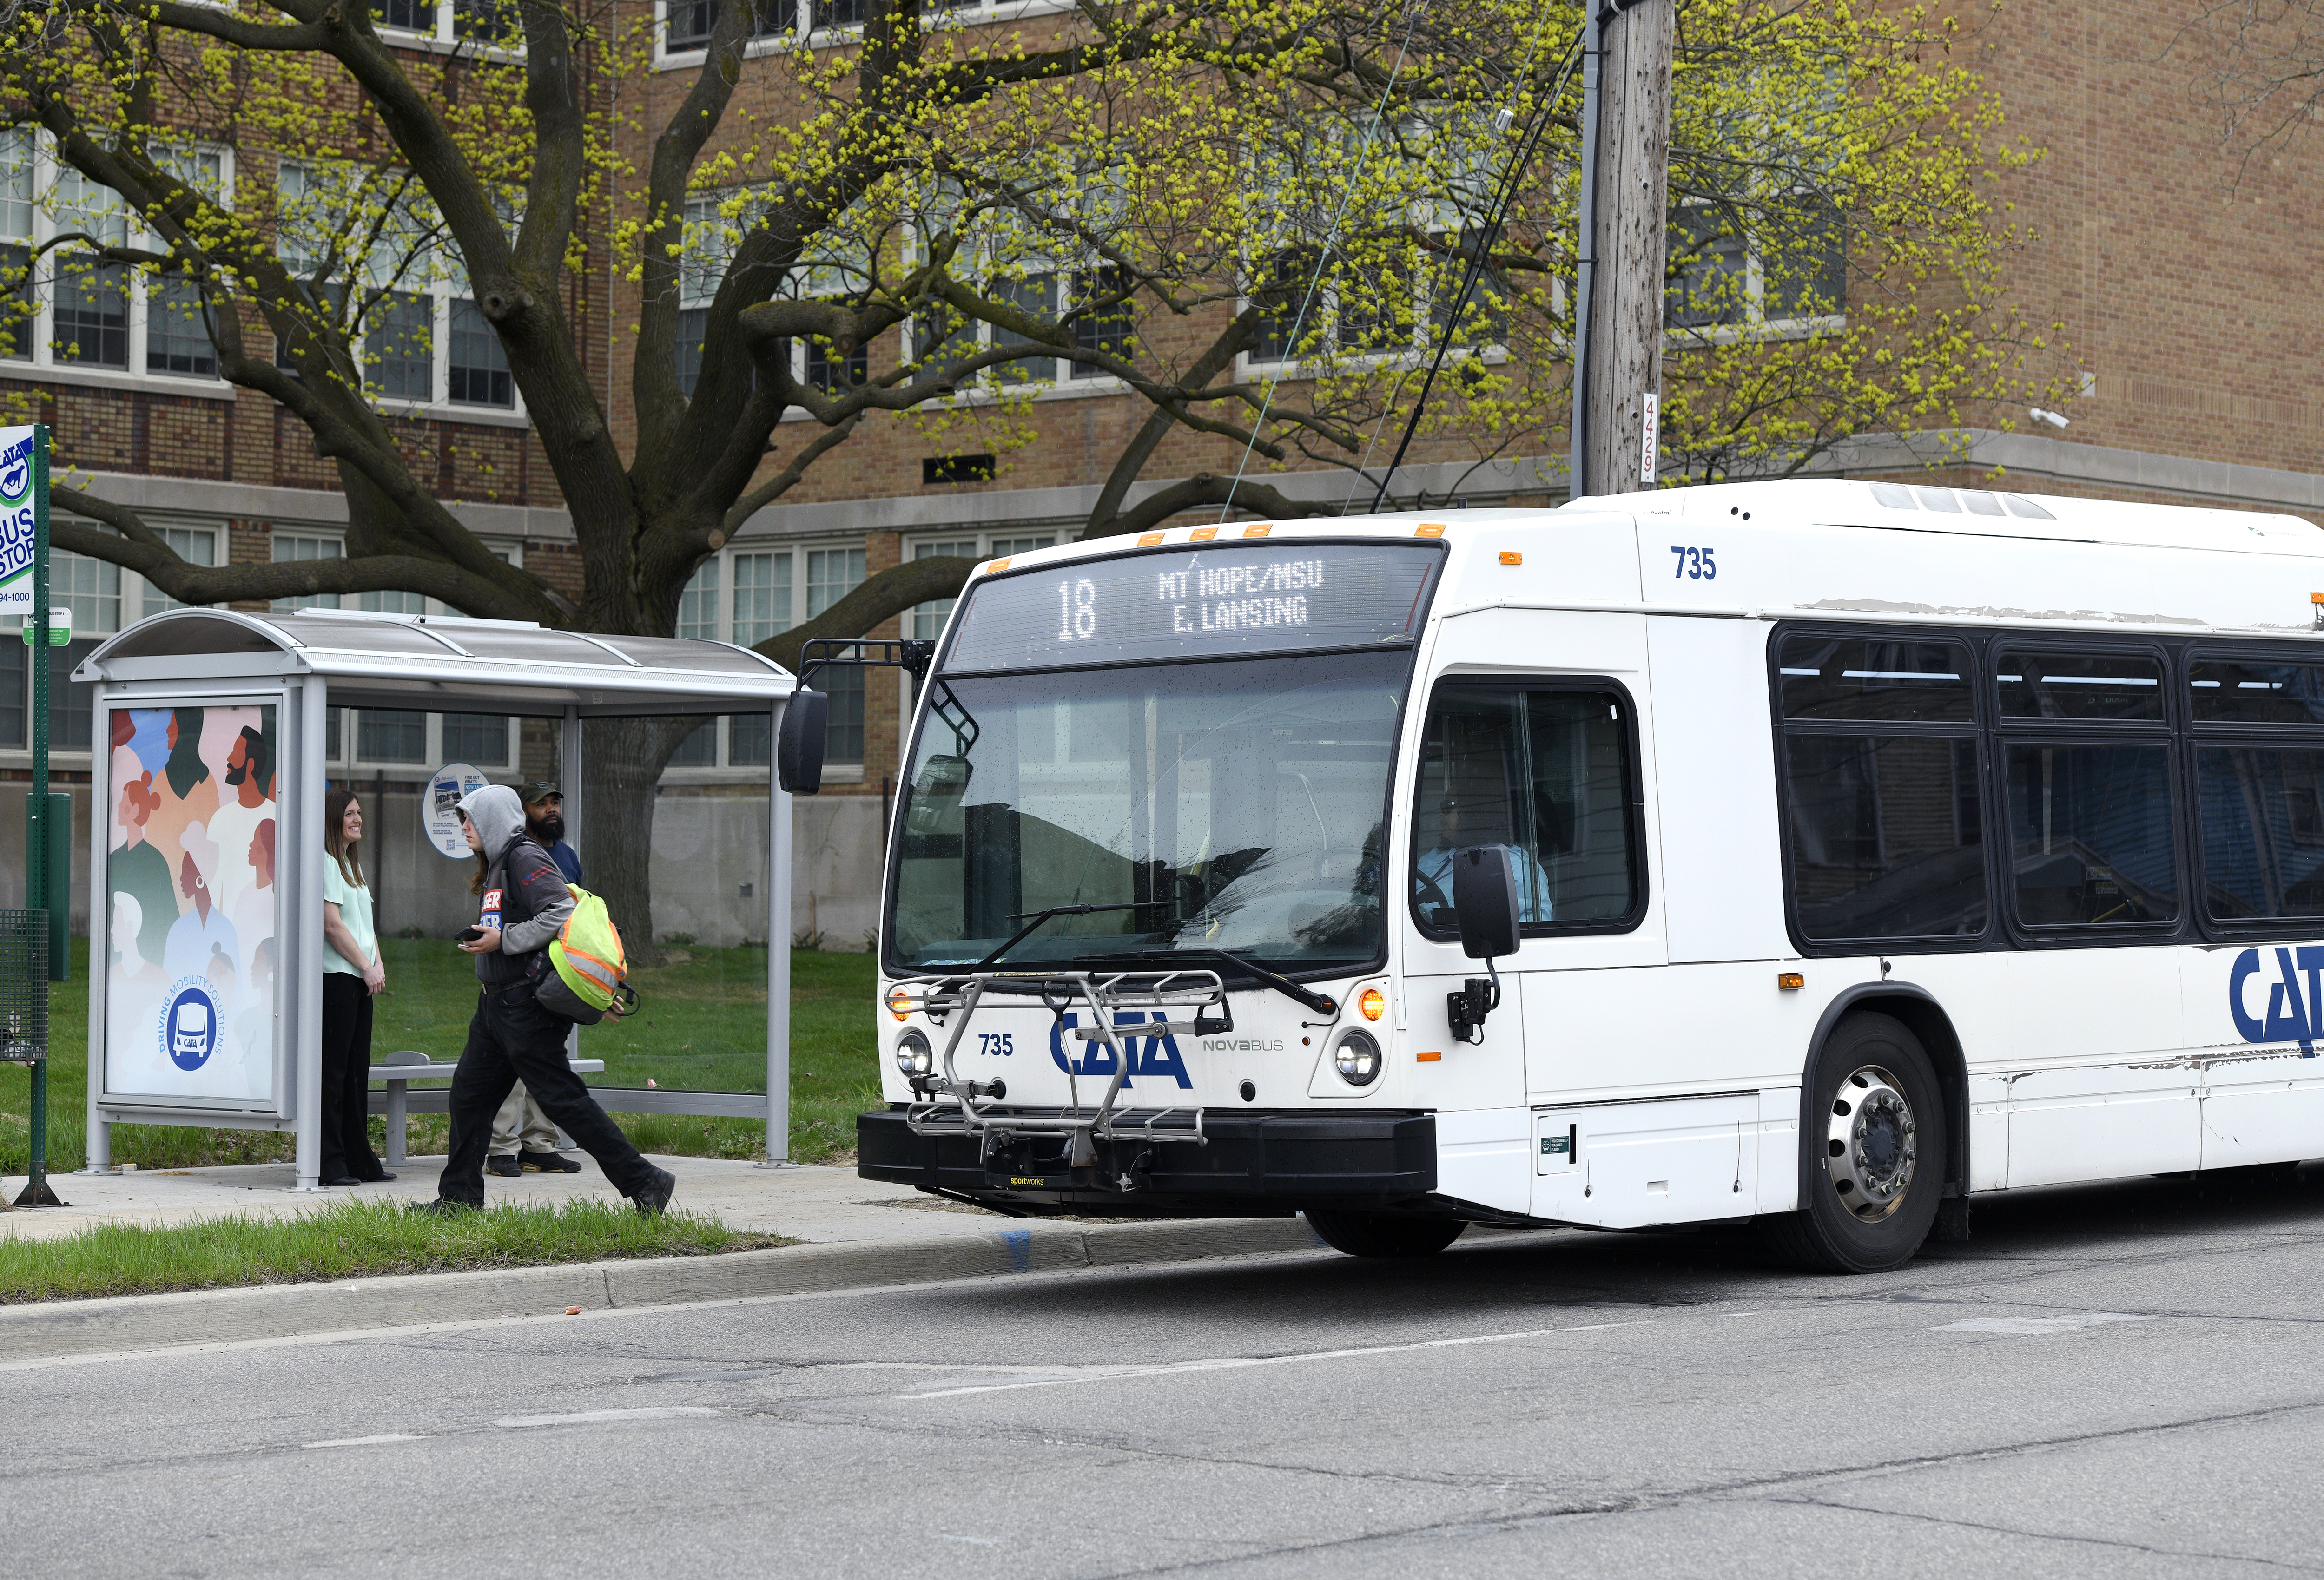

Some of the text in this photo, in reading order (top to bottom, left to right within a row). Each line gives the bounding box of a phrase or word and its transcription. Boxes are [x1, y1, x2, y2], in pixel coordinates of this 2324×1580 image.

[1644, 400, 1654, 472] 4429
[0, 442, 26, 469] ATA
[1159, 559, 1324, 600] MT HOPE/MSU
[1671, 546, 1716, 580] 735
[1058, 578, 1096, 641] 18
[1202, 596, 1307, 631] LANSING
[158, 974, 224, 1055] DRIVING MOBILITY SOLUTIONS
[2229, 946, 2324, 1059] CAT
[184, 1039, 198, 1049] CATA
[977, 1033, 1013, 1057] 735
[1048, 1011, 1193, 1089] CATA
[1010, 1177, 1045, 1186] sportworks
